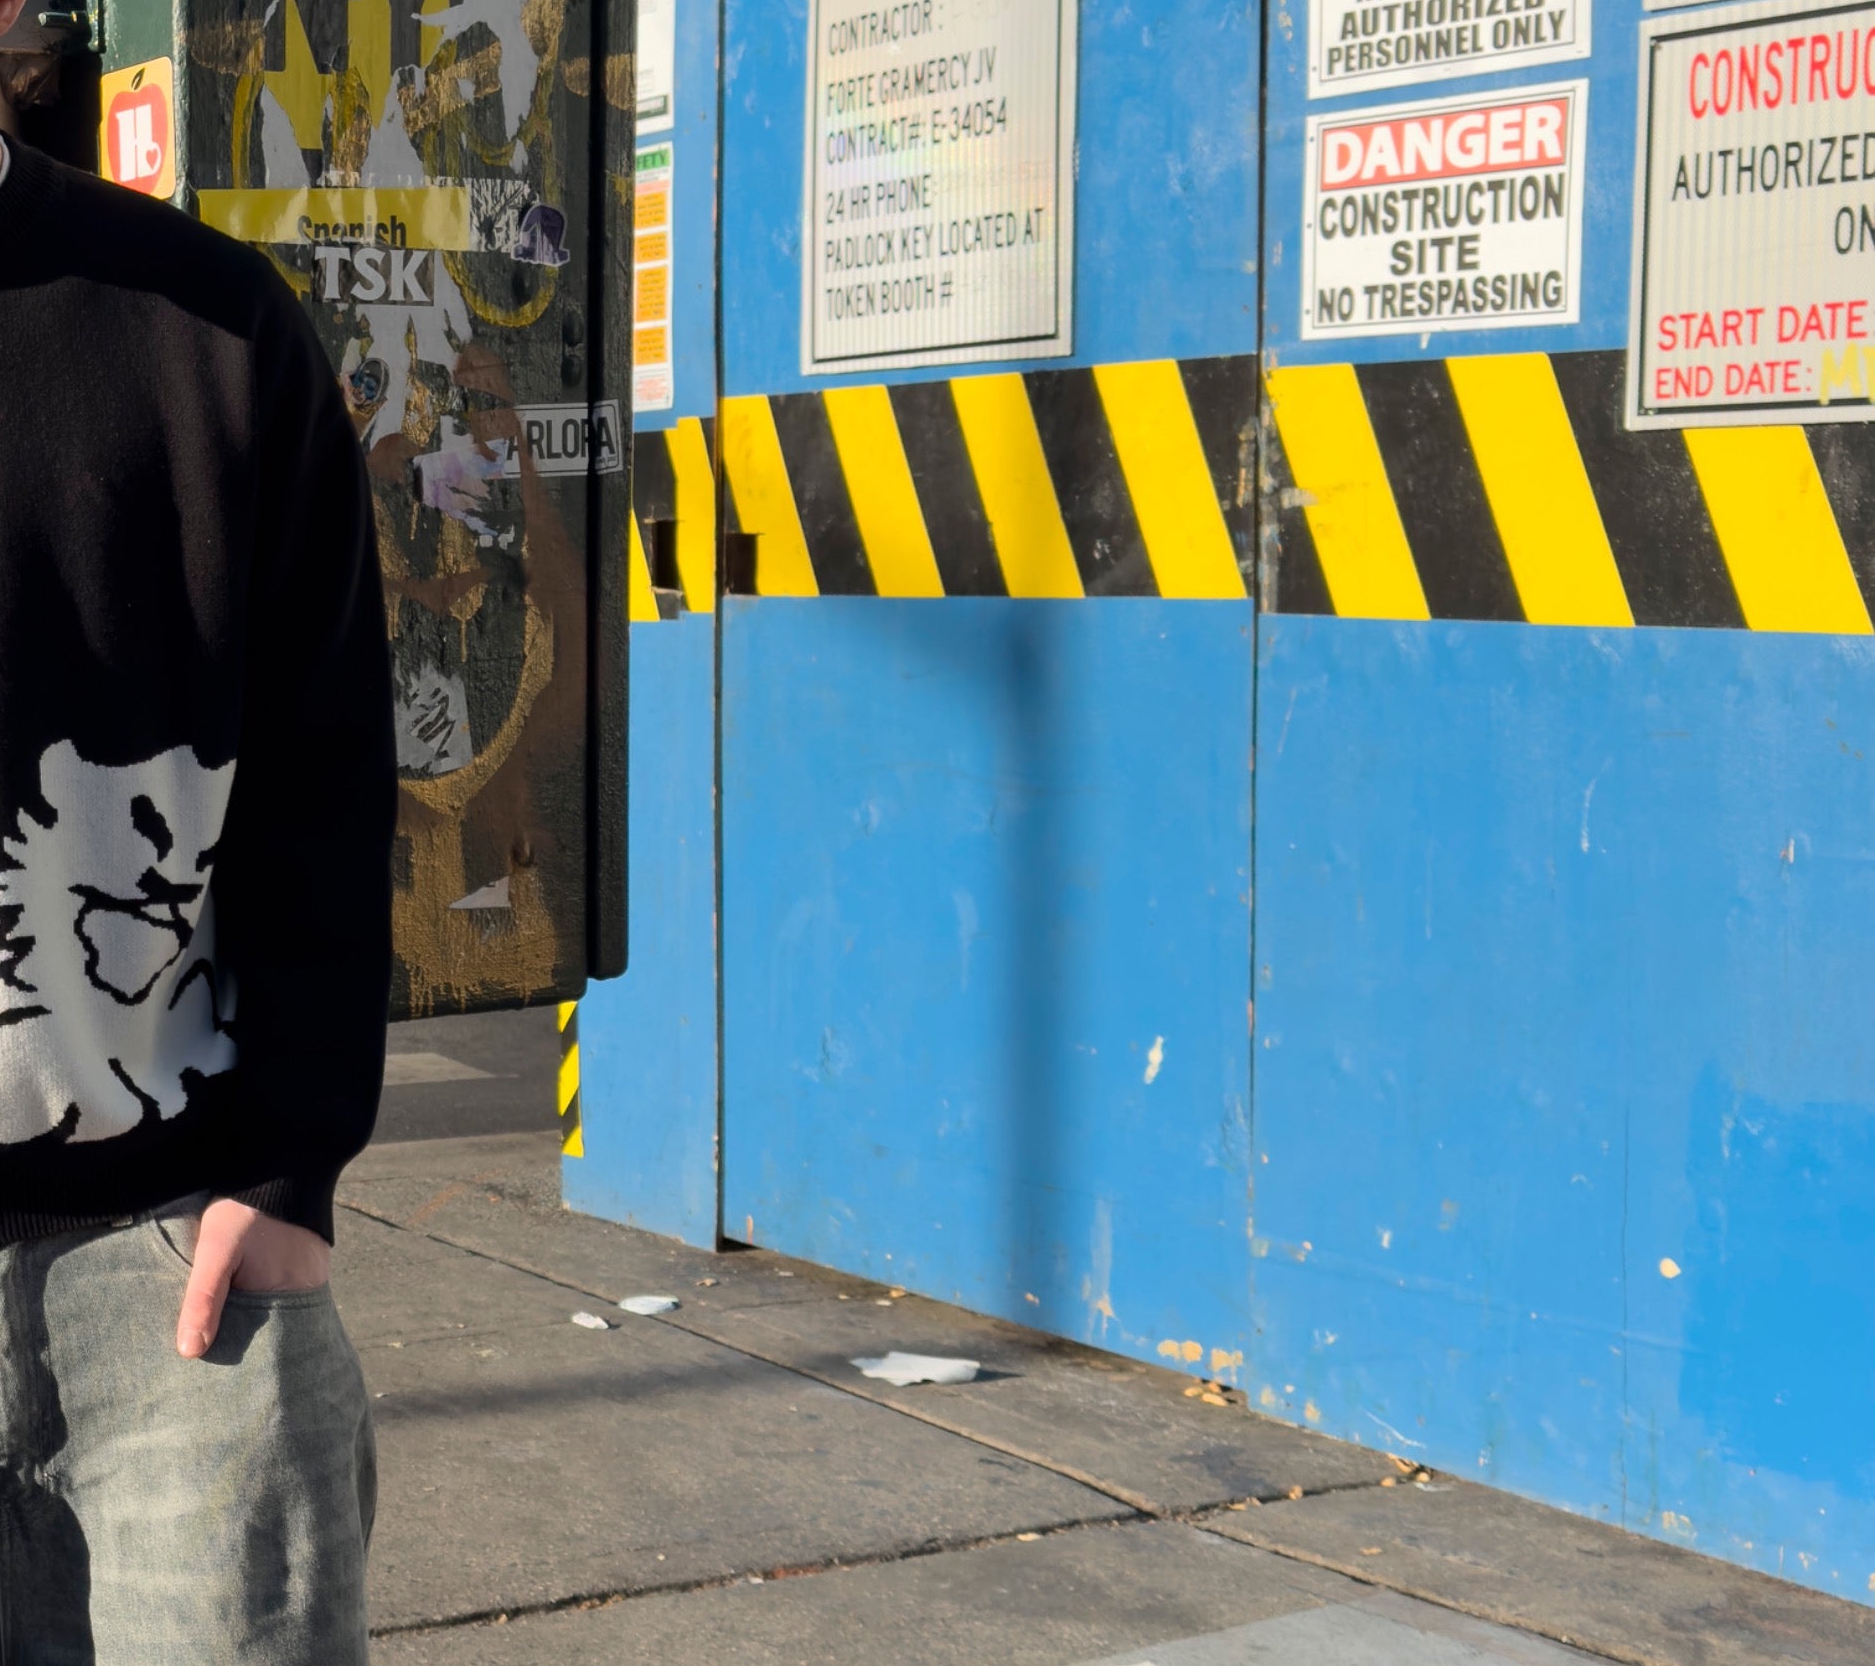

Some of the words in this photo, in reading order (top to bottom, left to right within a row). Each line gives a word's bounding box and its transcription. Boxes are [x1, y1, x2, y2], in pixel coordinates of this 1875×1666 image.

[1327, 24, 1483, 75] PERSONNEL
[1493, 9, 1566, 50] ONLY
[827, 74, 875, 117] FORTE
[879, 51, 971, 105] GRAMERCY
[974, 46, 996, 85] JV
[1324, 105, 1563, 183] DANGER
[827, 190, 844, 224] 24
[850, 185, 870, 221] HR
[1320, 172, 1565, 240] CONSTRUCTION
[826, 225, 895, 272] PADLOCK
[901, 222, 934, 261] KEY
[940, 212, 1017, 257] LOCATED
[1023, 207, 1044, 245] AT
[1390, 234, 1480, 276] SITE
[314, 245, 430, 303] TSK
[826, 283, 875, 322] TOKEN
[882, 275, 935, 314] BOOTH
[1319, 287, 1354, 323] NO
[1364, 270, 1563, 320] TRESPASSING
[1657, 307, 1765, 352] START
[1655, 364, 1714, 400] END
